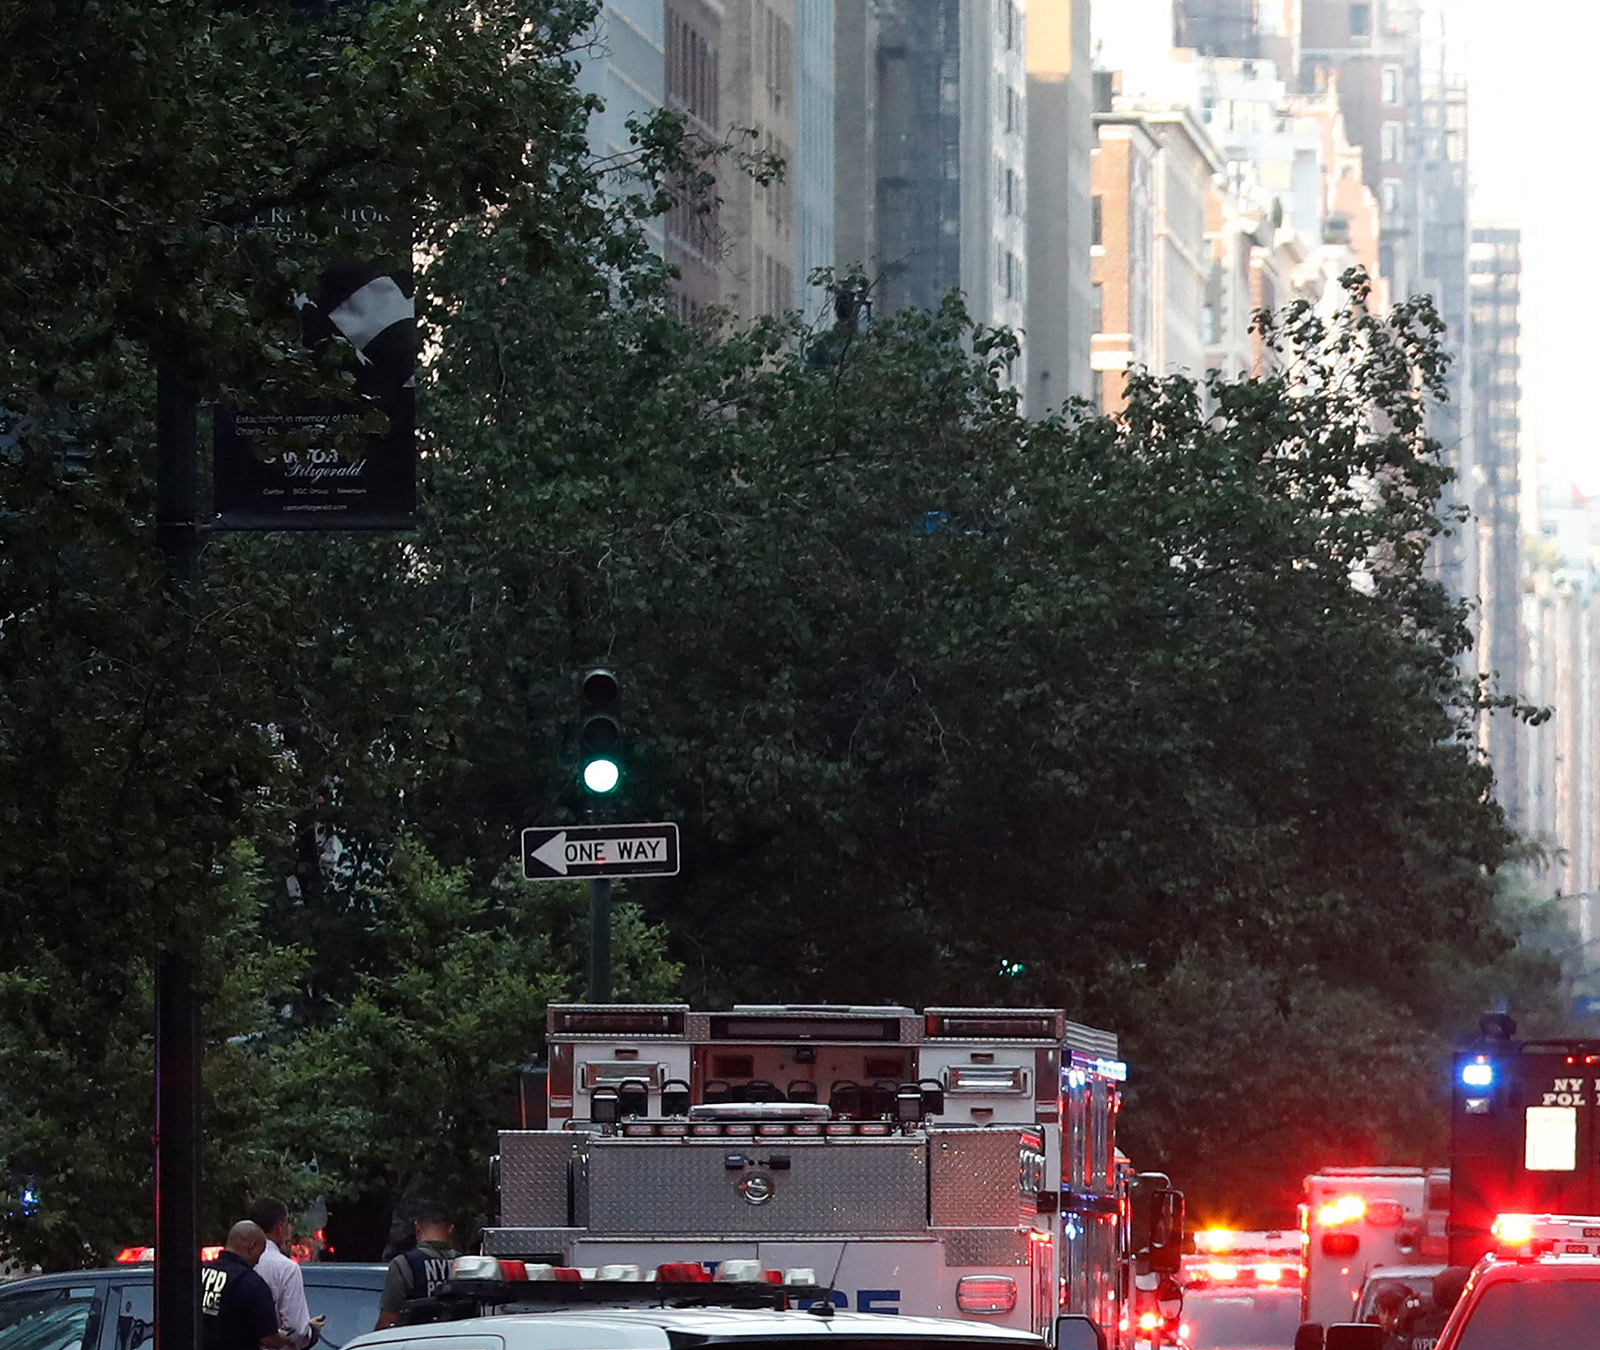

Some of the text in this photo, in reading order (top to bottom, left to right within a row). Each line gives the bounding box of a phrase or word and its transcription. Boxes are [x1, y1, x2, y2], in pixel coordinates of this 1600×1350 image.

[564, 841, 660, 862] ONE WAY
[202, 1267, 227, 1290] YPD
